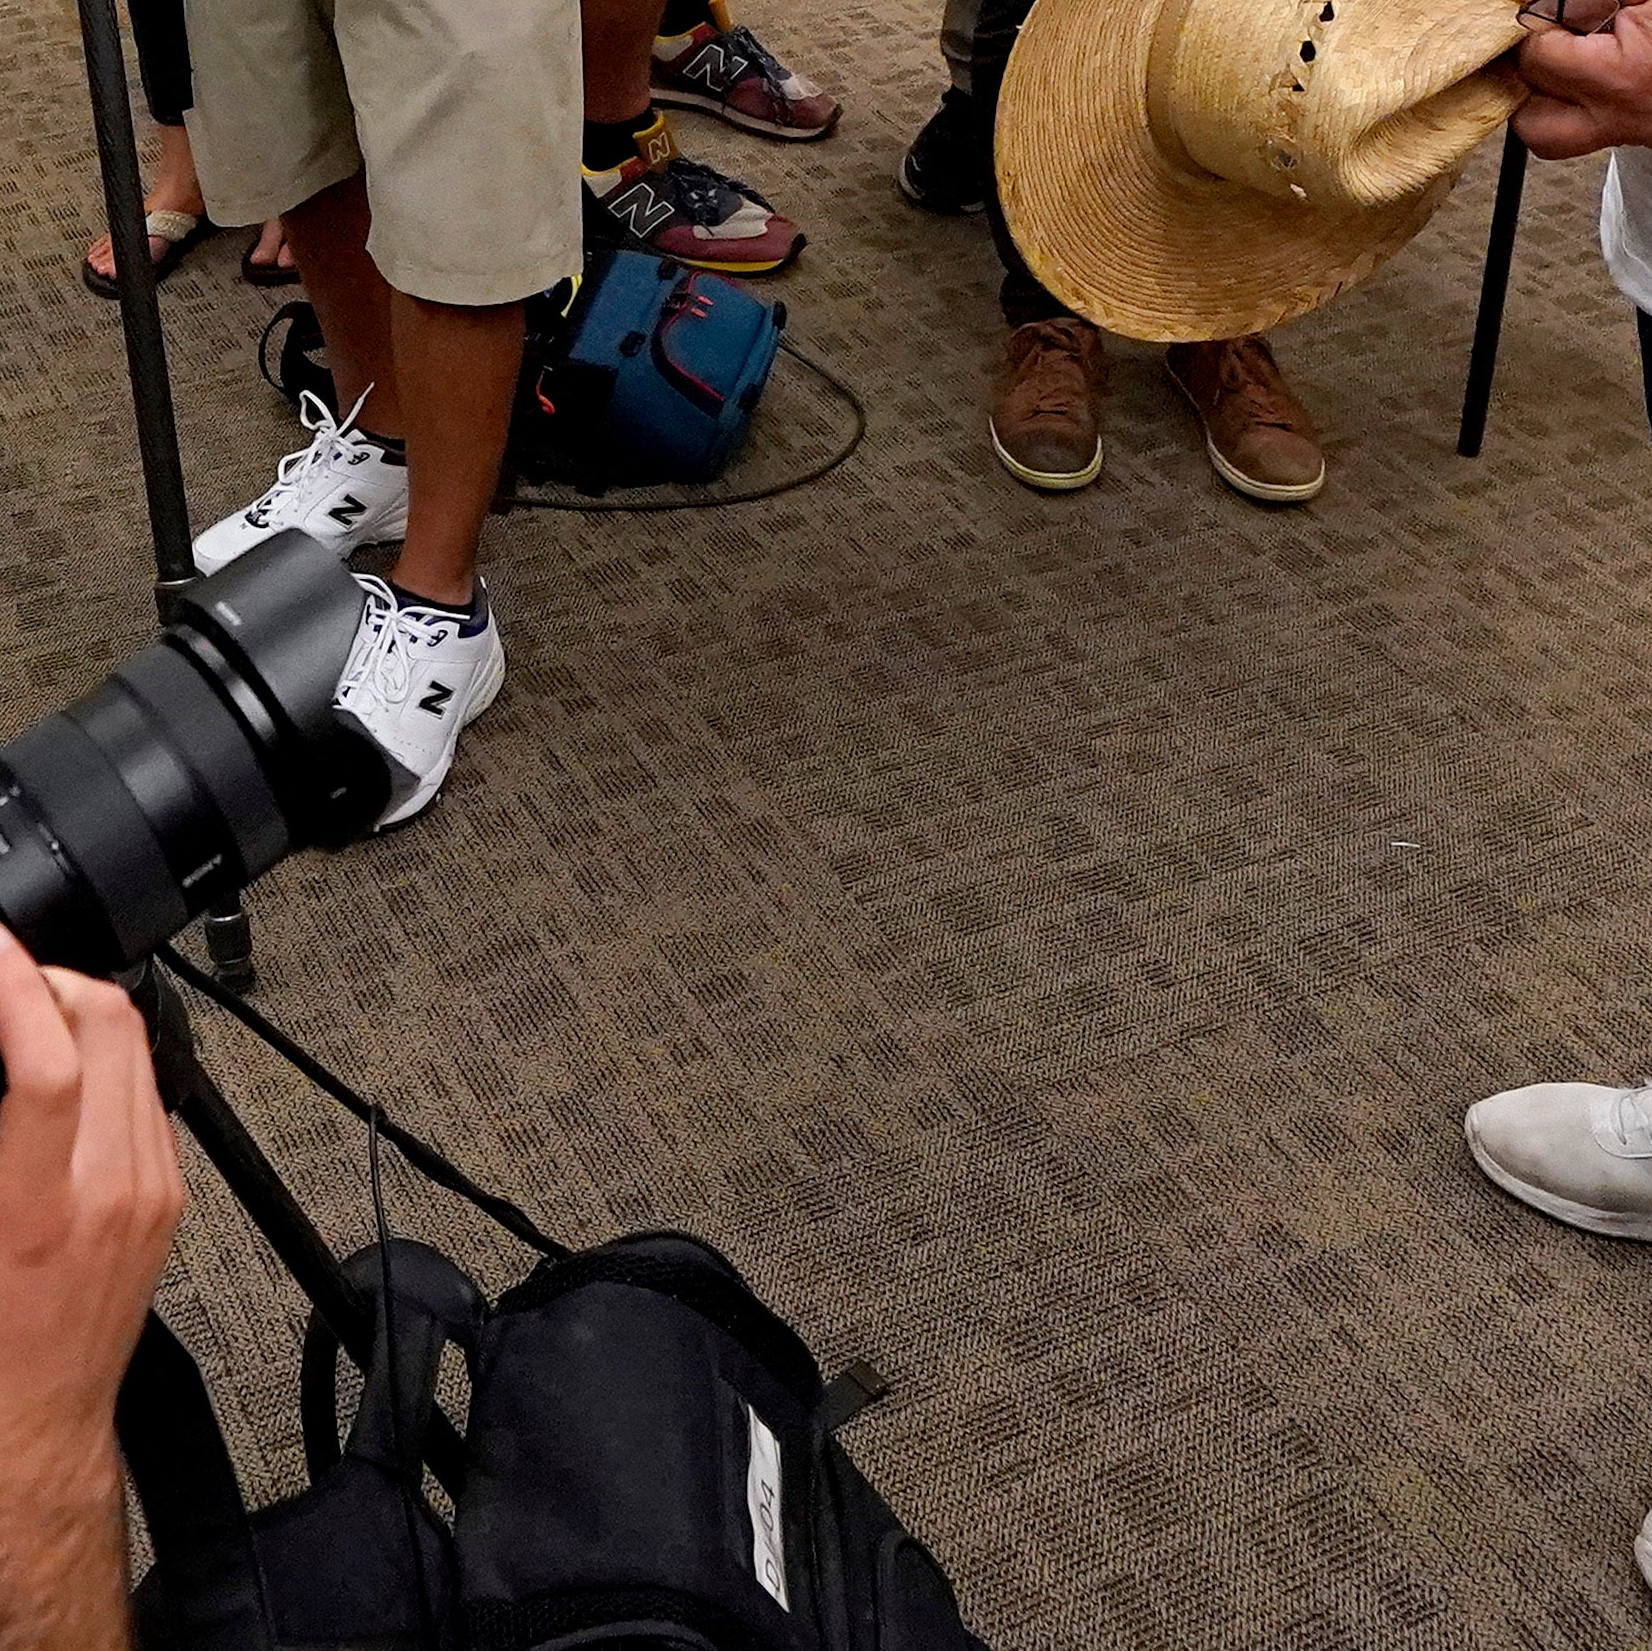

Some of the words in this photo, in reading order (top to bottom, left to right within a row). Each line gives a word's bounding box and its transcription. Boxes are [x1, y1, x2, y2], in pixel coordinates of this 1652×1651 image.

[682, 43, 749, 93] N
[648, 131, 671, 165] N
[608, 182, 676, 239] N
[327, 493, 368, 531] N
[417, 679, 455, 720] N
